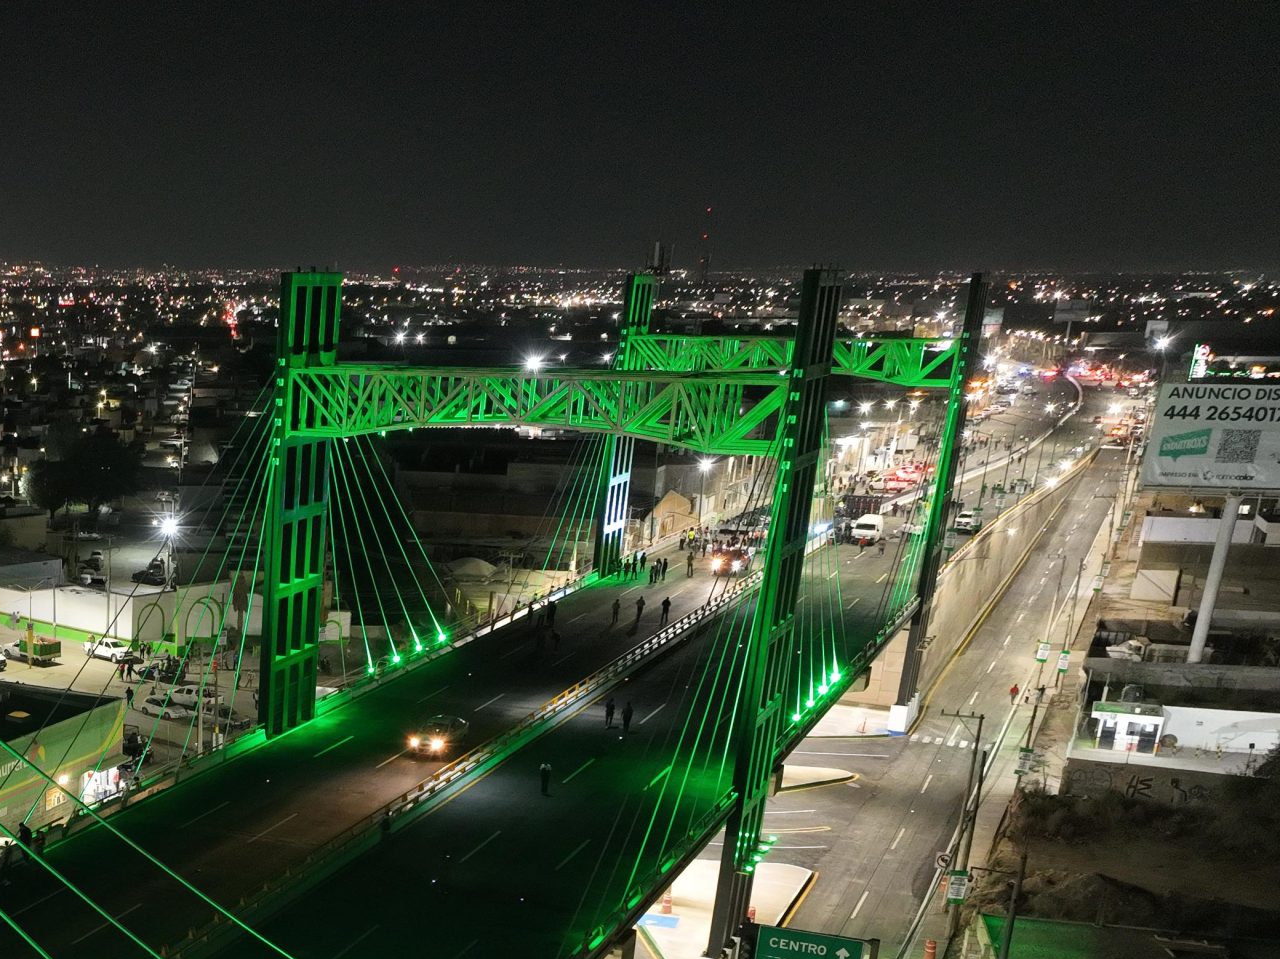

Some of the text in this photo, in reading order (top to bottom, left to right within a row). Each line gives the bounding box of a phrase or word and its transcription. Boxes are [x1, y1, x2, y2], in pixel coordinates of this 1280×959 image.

[1168, 387, 1251, 400] ANUNCIO
[1163, 405, 1201, 420] 444
[769, 937, 827, 956] CENTRO
